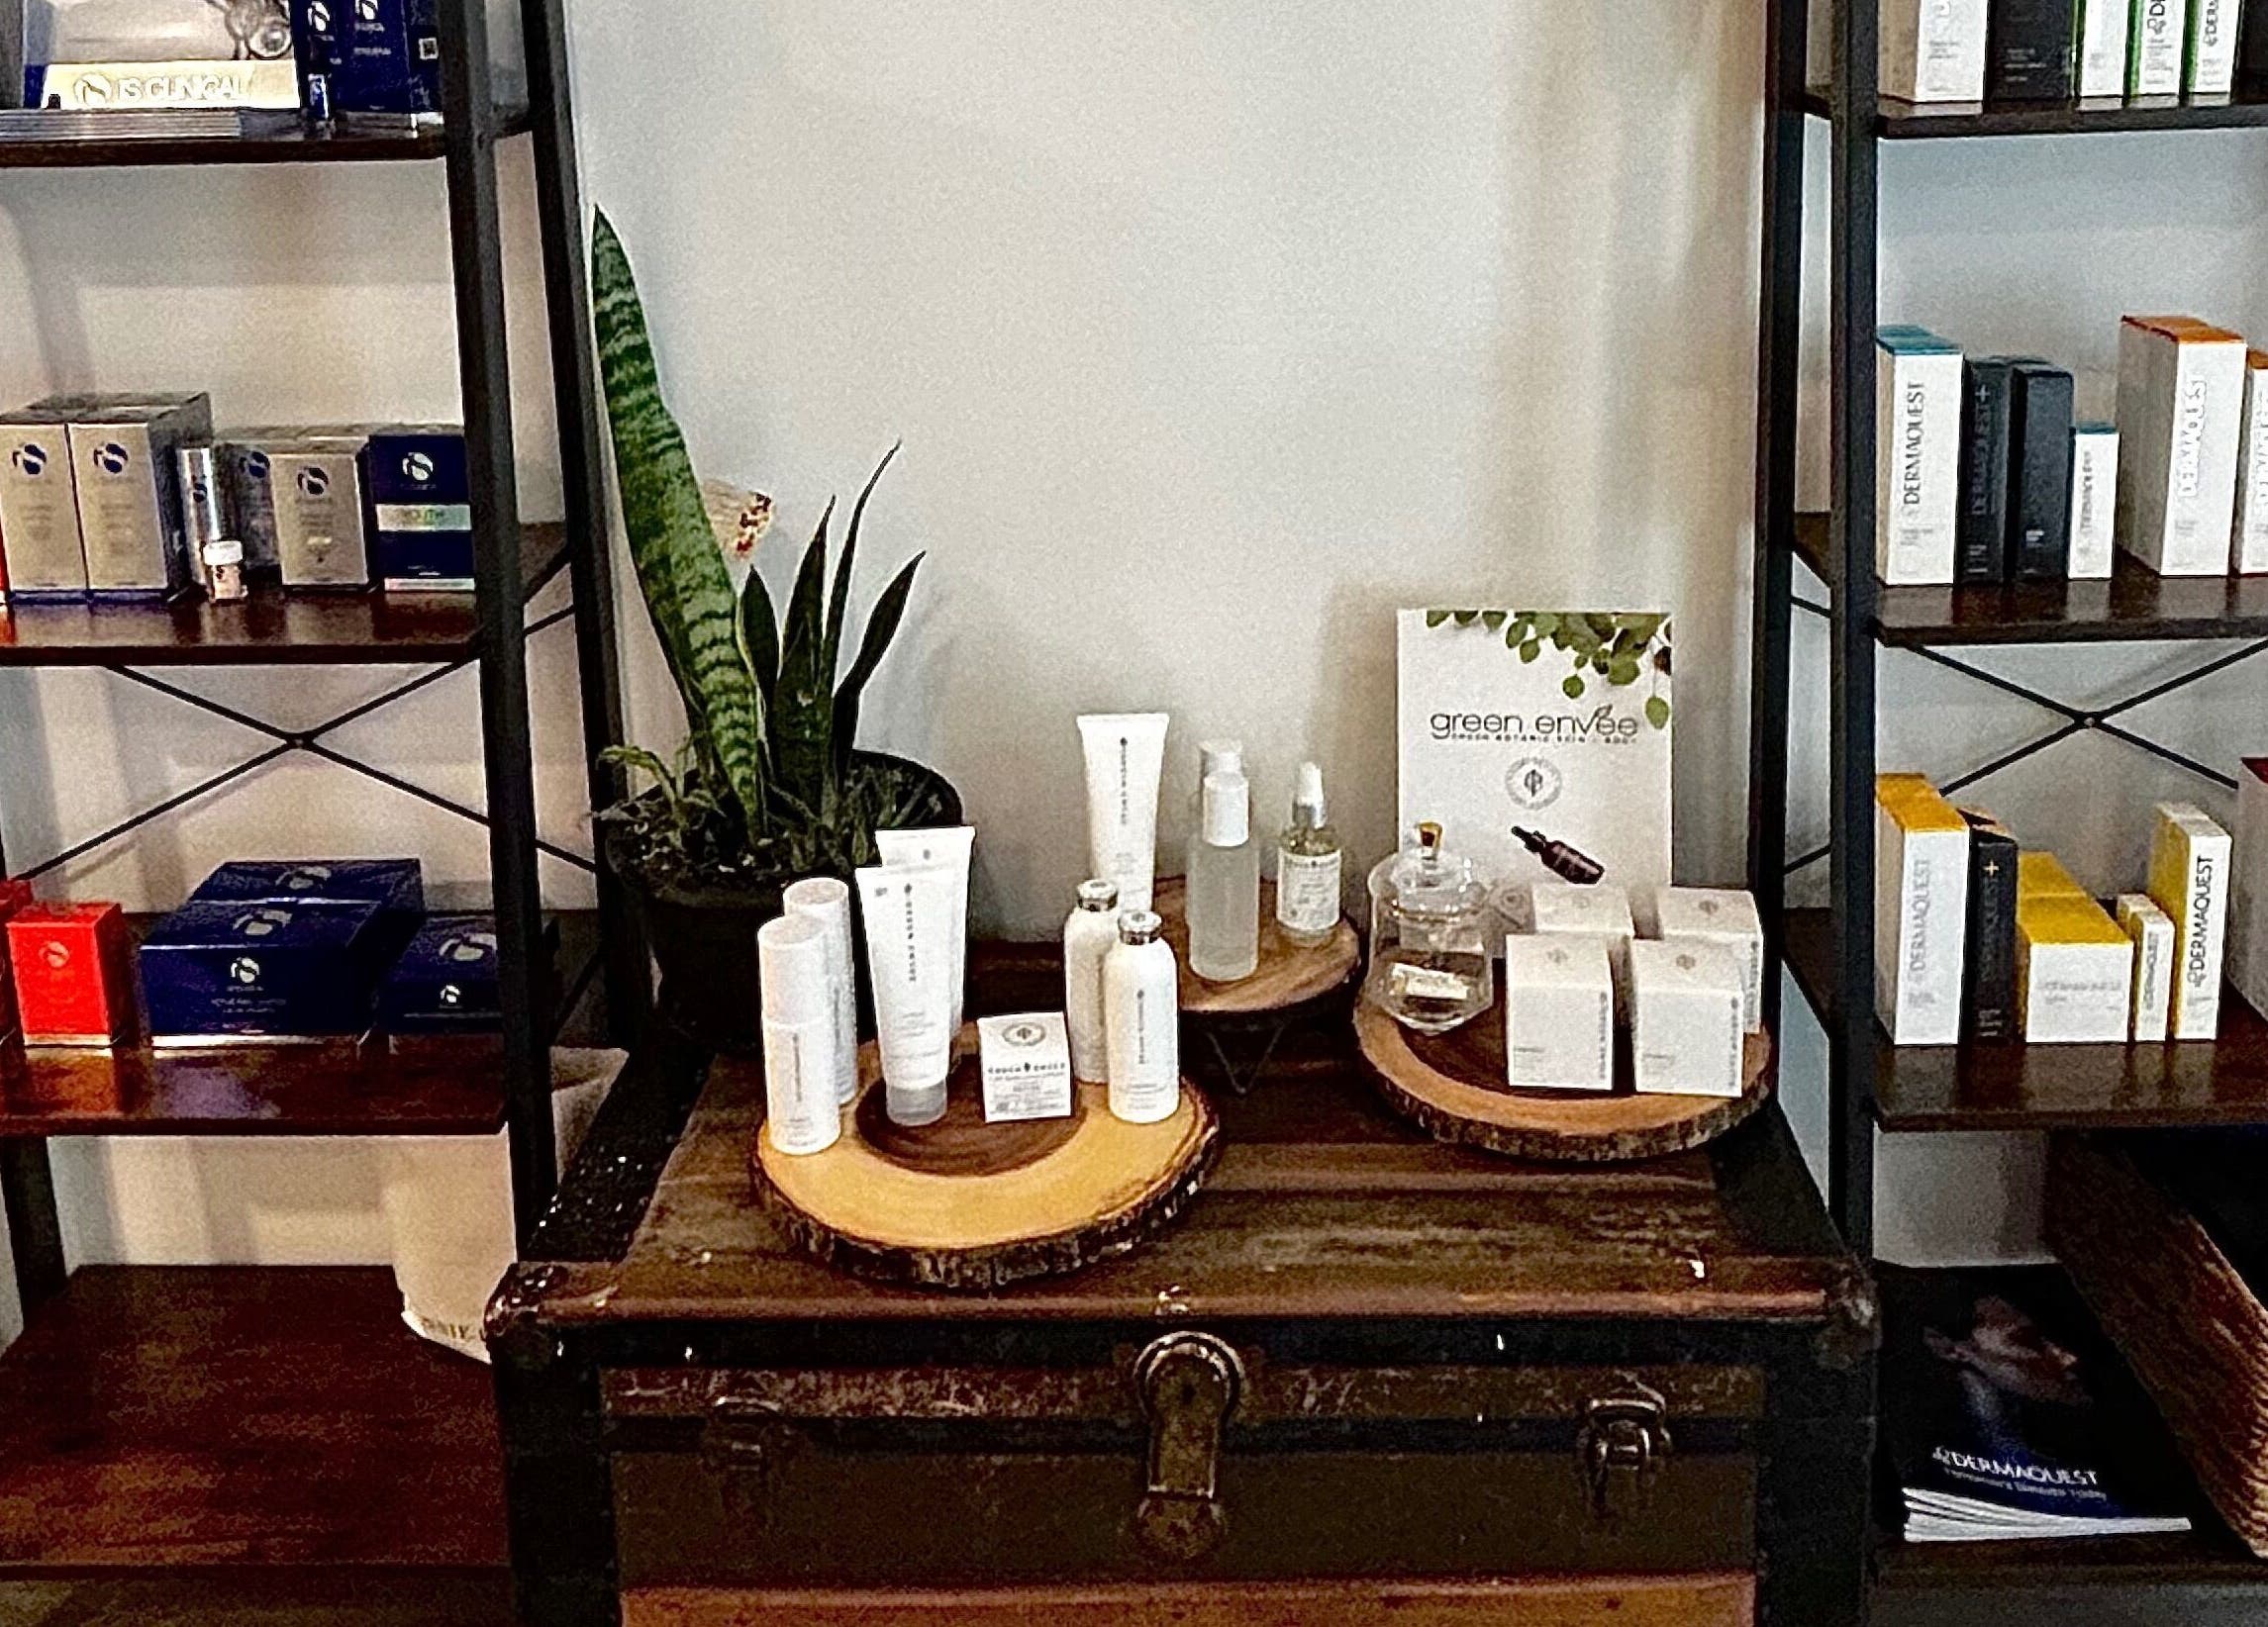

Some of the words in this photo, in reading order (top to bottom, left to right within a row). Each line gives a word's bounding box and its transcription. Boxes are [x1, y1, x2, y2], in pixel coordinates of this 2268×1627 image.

[1903, 381, 1924, 505] DERMAQUEST
[1430, 714, 1524, 739] green
[1910, 859, 1930, 972] DERMAQUEST
[2191, 855, 2214, 971] DERMAQUEST
